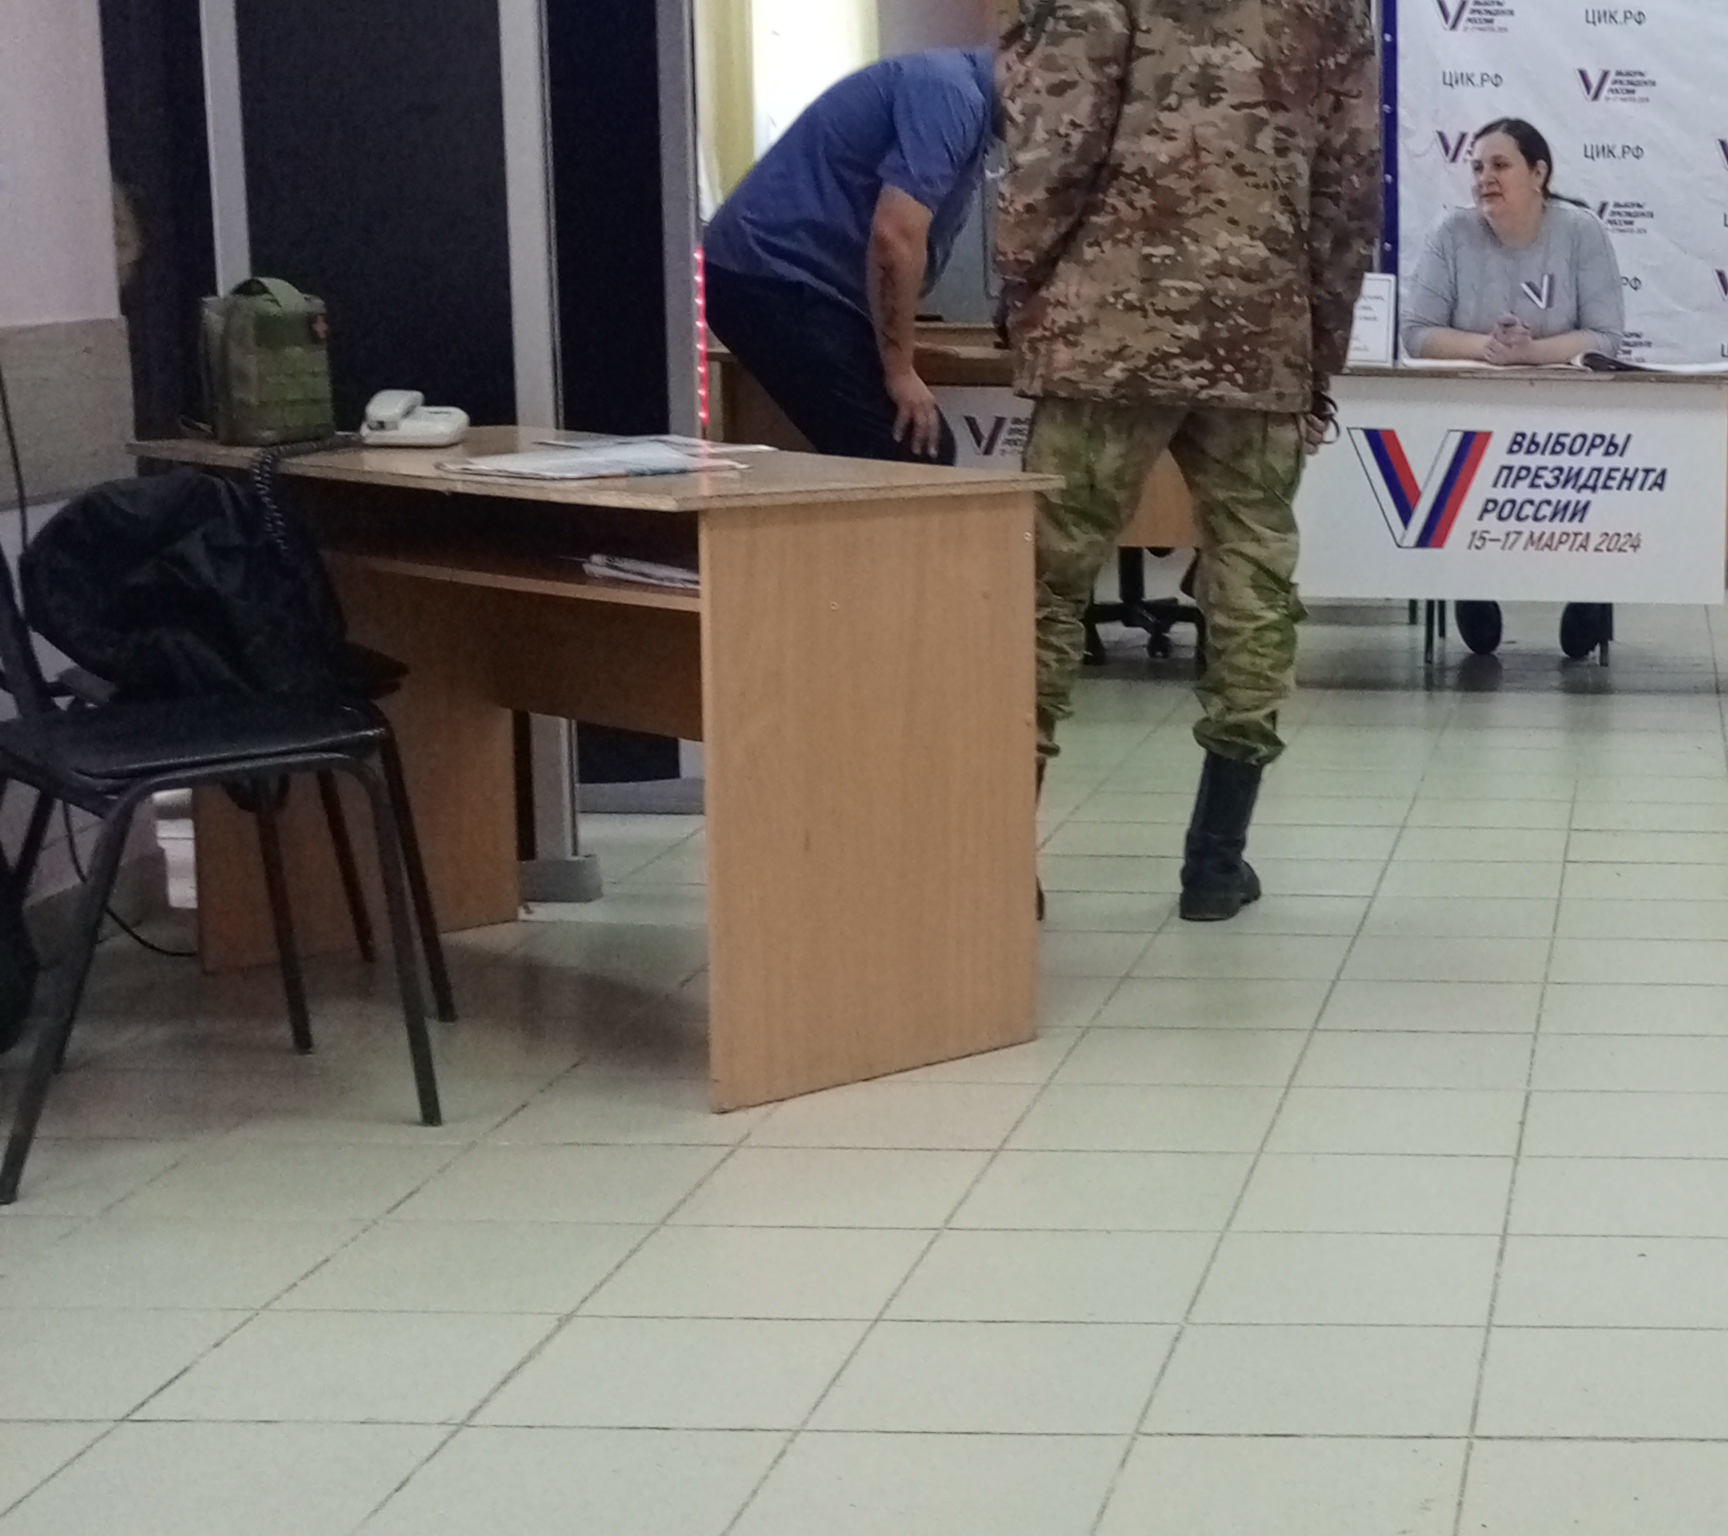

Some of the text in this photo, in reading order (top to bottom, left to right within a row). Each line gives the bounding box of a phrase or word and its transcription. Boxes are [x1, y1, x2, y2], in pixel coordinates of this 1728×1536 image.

[1584, 8, 1646, 27] ЦИК.РФ
[1442, 70, 1503, 89] ЦИК.РФ
[1583, 143, 1644, 161] ЦИК.РФ
[1506, 432, 1632, 457] ВЫБОРЫ
[1492, 465, 1667, 493] ПРЕЗИДЕНТА
[1477, 498, 1591, 523] РОССИИ
[1523, 531, 1590, 552] МАРТА
[1594, 532, 1641, 553] 2024
